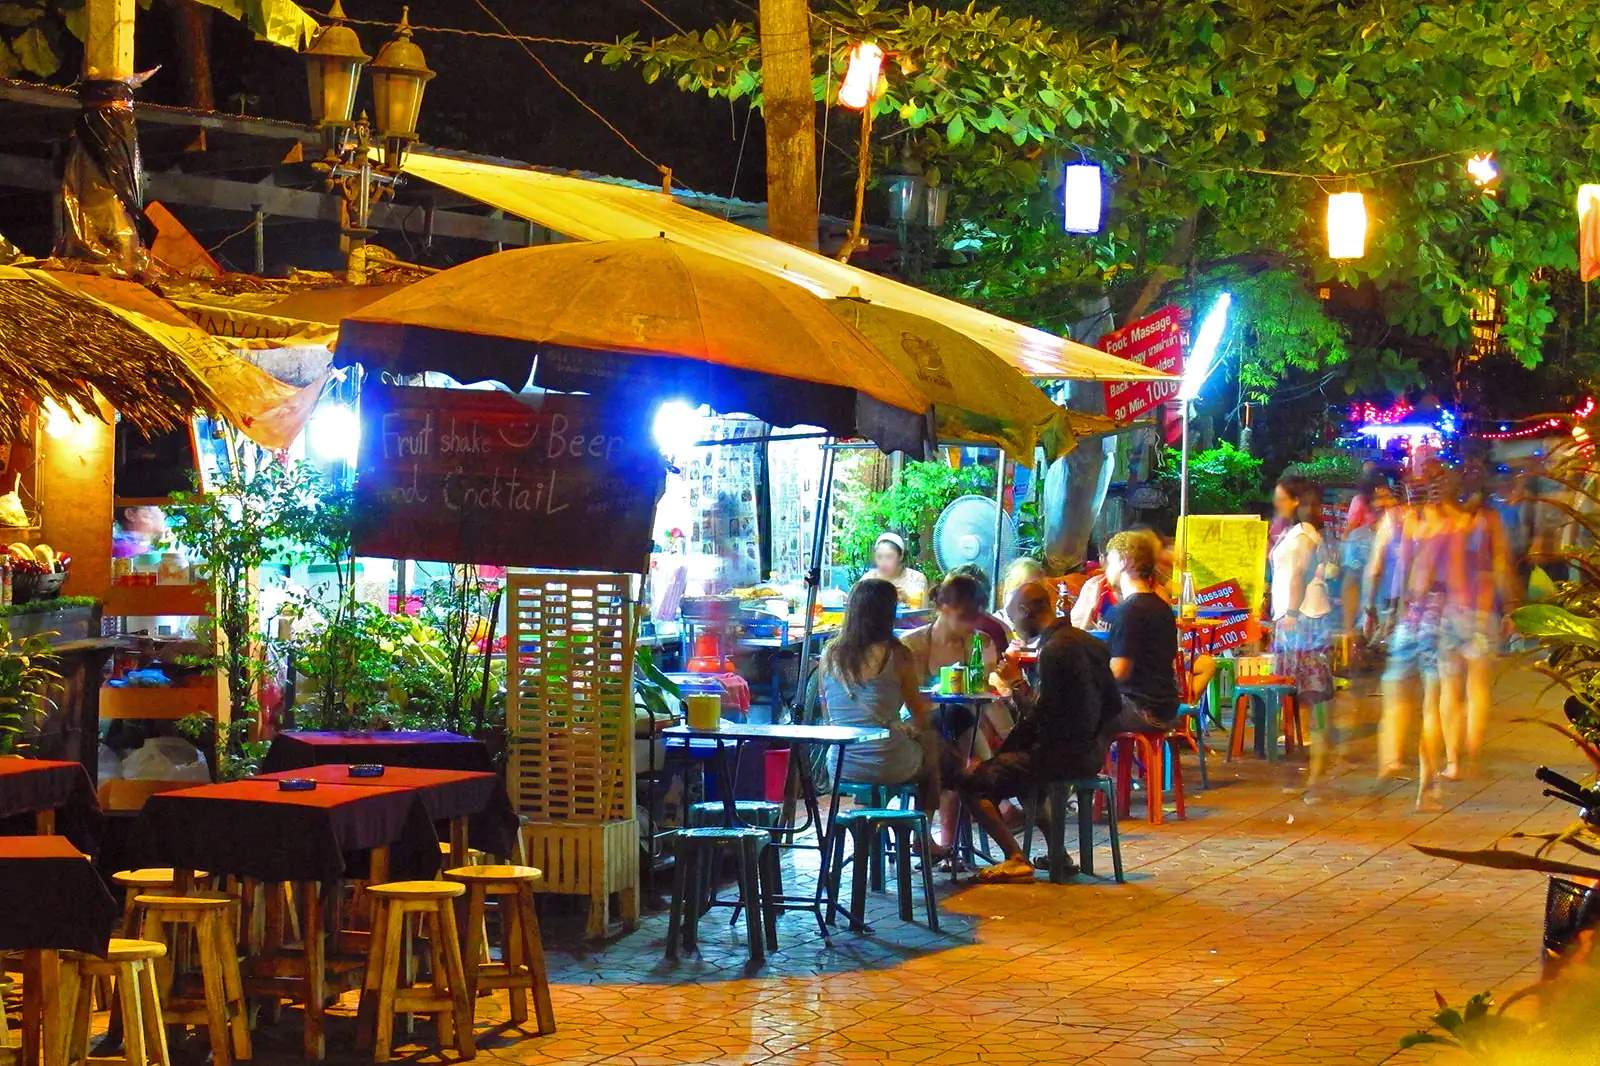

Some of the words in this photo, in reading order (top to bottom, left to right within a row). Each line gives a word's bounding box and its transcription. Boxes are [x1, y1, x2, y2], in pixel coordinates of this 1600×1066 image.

[1106, 335, 1128, 353] Foot
[1131, 315, 1171, 343] Massage
[1110, 380, 1129, 398] Back
[1114, 406, 1126, 420] 30
[1129, 398, 1148, 414] Min.
[1146, 380, 1168, 403] 100
[382, 412, 433, 459] Fruit
[440, 417, 490, 454] shake
[547, 412, 624, 459] Beer
[1194, 586, 1234, 605] Massage
[1220, 630, 1238, 645] 100
